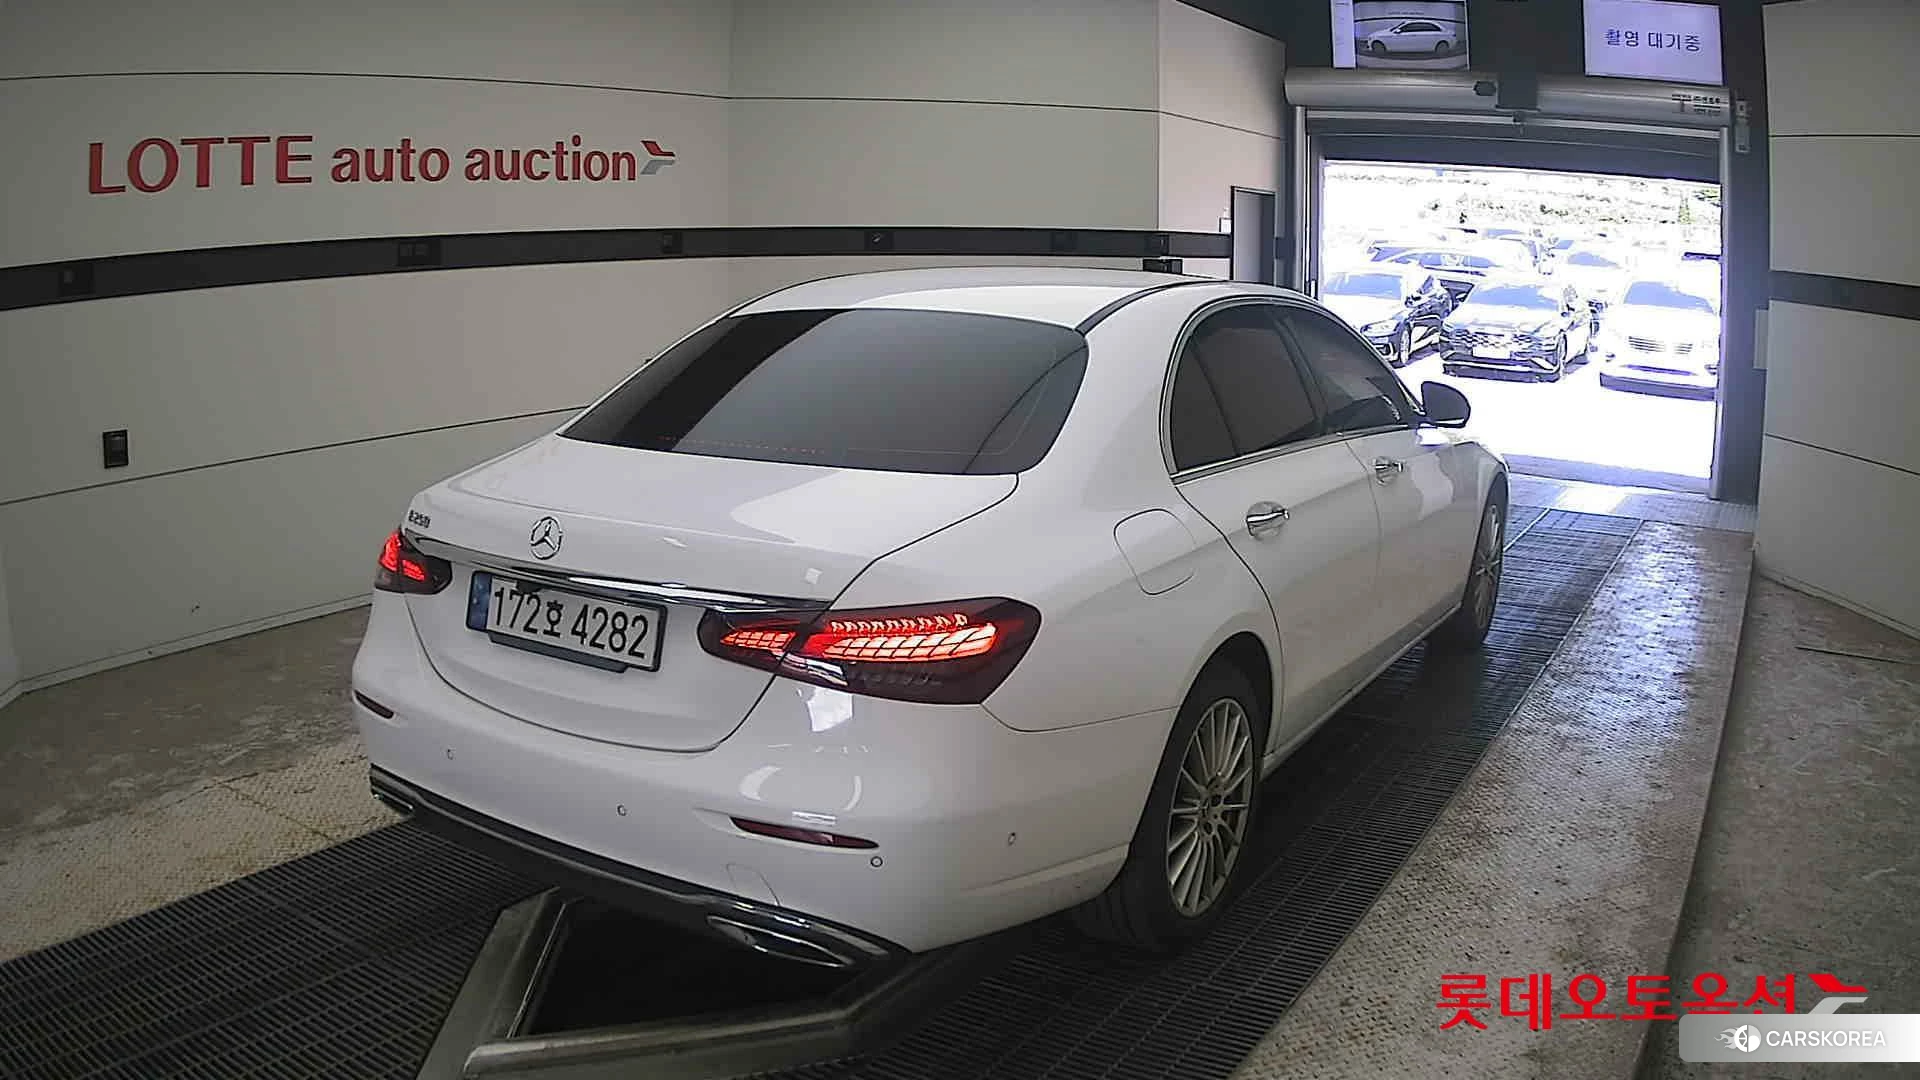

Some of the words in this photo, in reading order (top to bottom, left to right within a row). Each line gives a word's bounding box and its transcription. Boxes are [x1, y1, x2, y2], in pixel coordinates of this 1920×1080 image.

[1606, 28, 1639, 47] 촬영
[1648, 32, 1701, 52] 대기중
[89, 136, 312, 194] LOTTE
[331, 138, 449, 183] auto
[465, 135, 637, 182] auction
[494, 587, 563, 638] 172호
[571, 604, 648, 659] 4282
